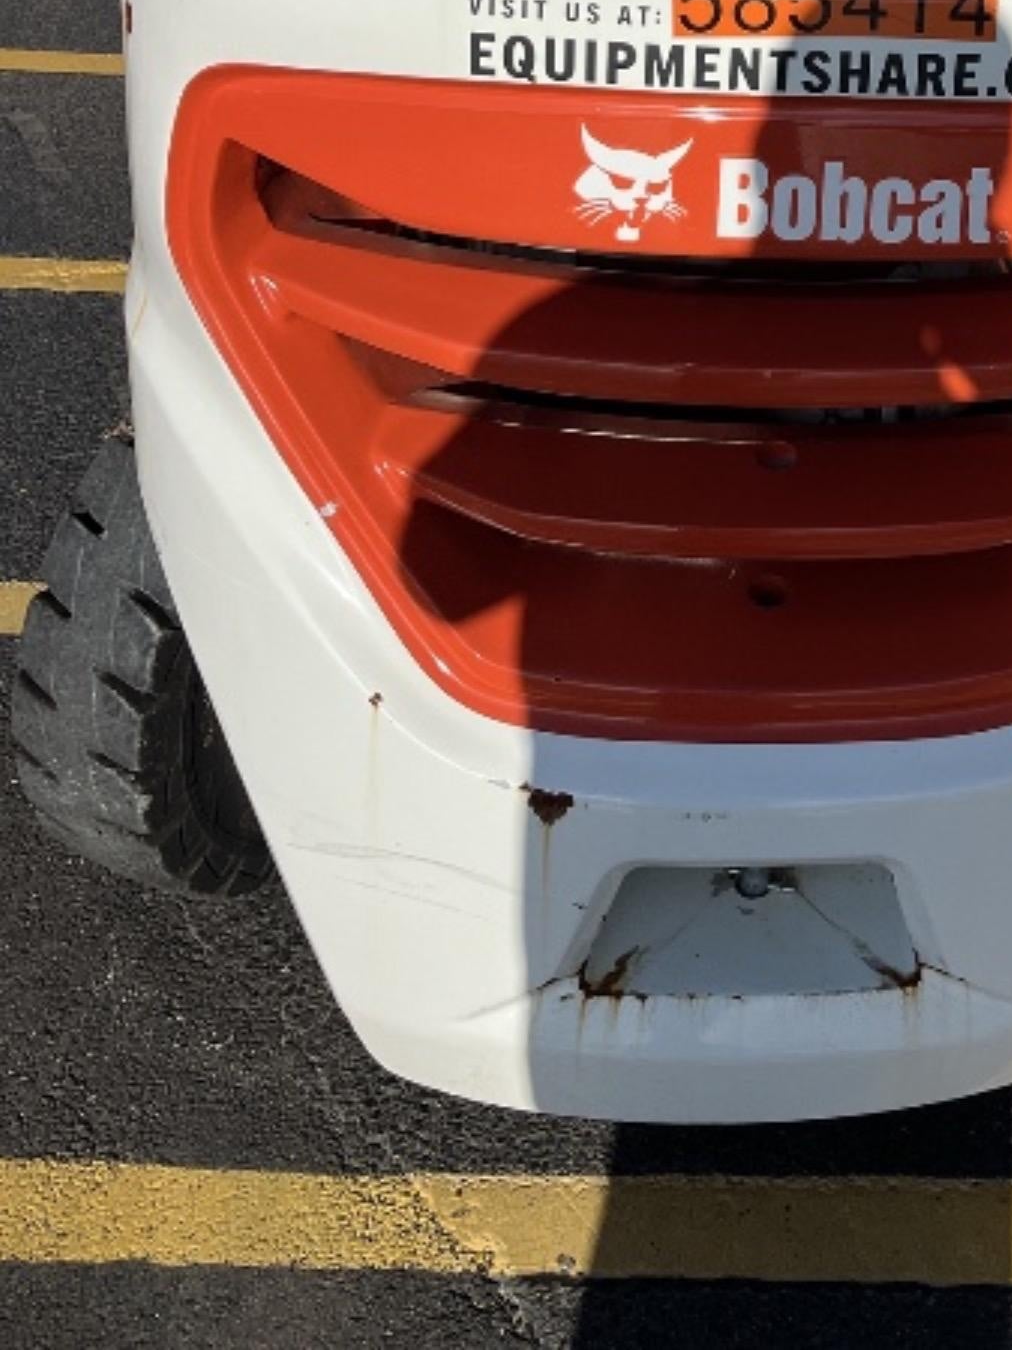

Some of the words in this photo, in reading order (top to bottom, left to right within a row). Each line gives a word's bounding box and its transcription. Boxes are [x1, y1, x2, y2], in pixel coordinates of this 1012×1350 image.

[565, 2, 600, 25] US
[617, 5, 661, 27] AT:
[716, 157, 993, 245] Bobcat
